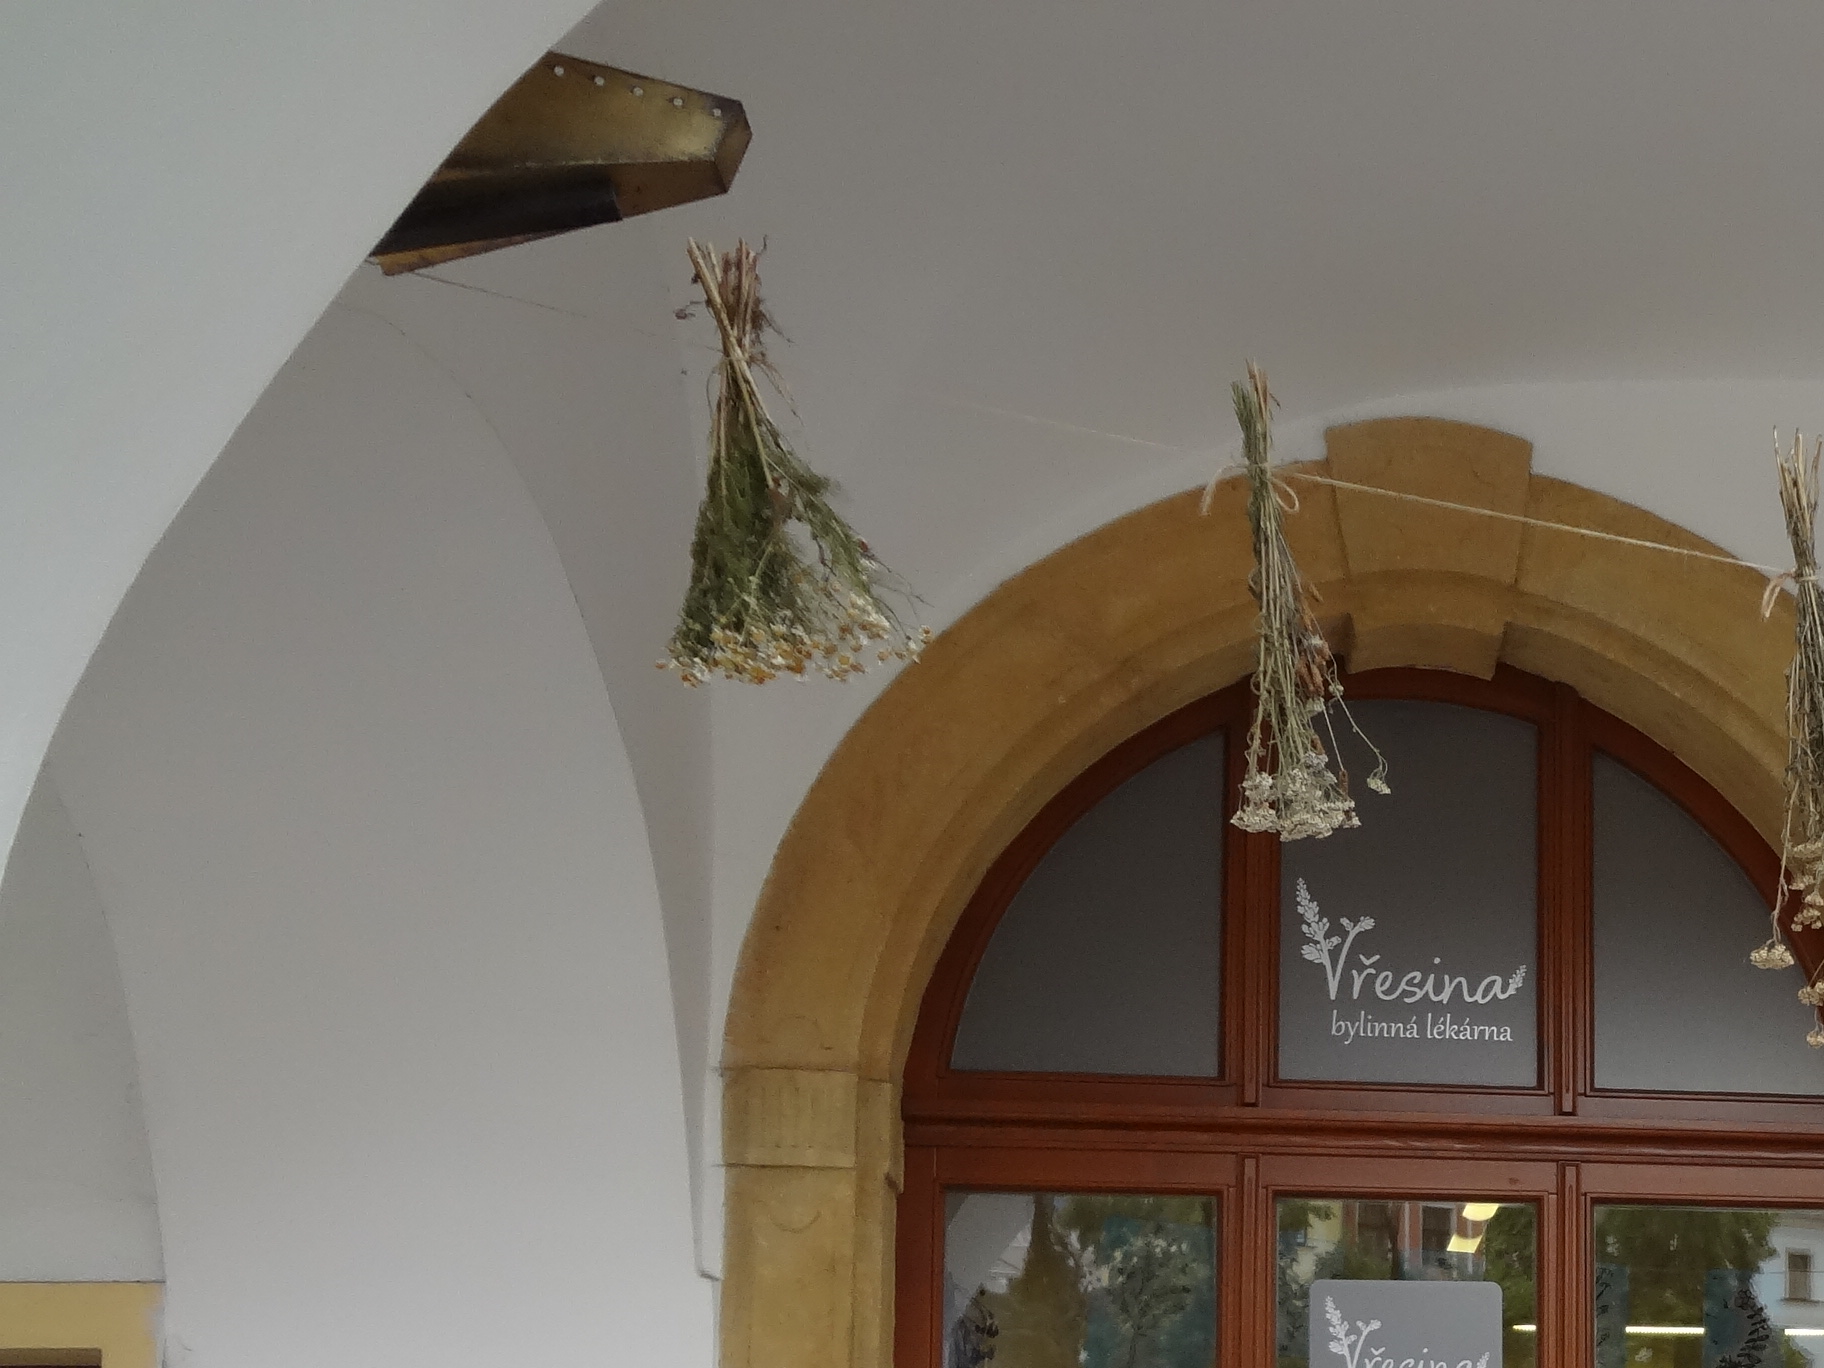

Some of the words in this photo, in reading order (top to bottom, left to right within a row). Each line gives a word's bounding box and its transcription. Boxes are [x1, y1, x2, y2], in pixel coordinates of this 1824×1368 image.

[1295, 877, 1527, 1005] Vřesina
[1331, 1010, 1420, 1043] bylinná
[1426, 1013, 1513, 1043] lékárna
